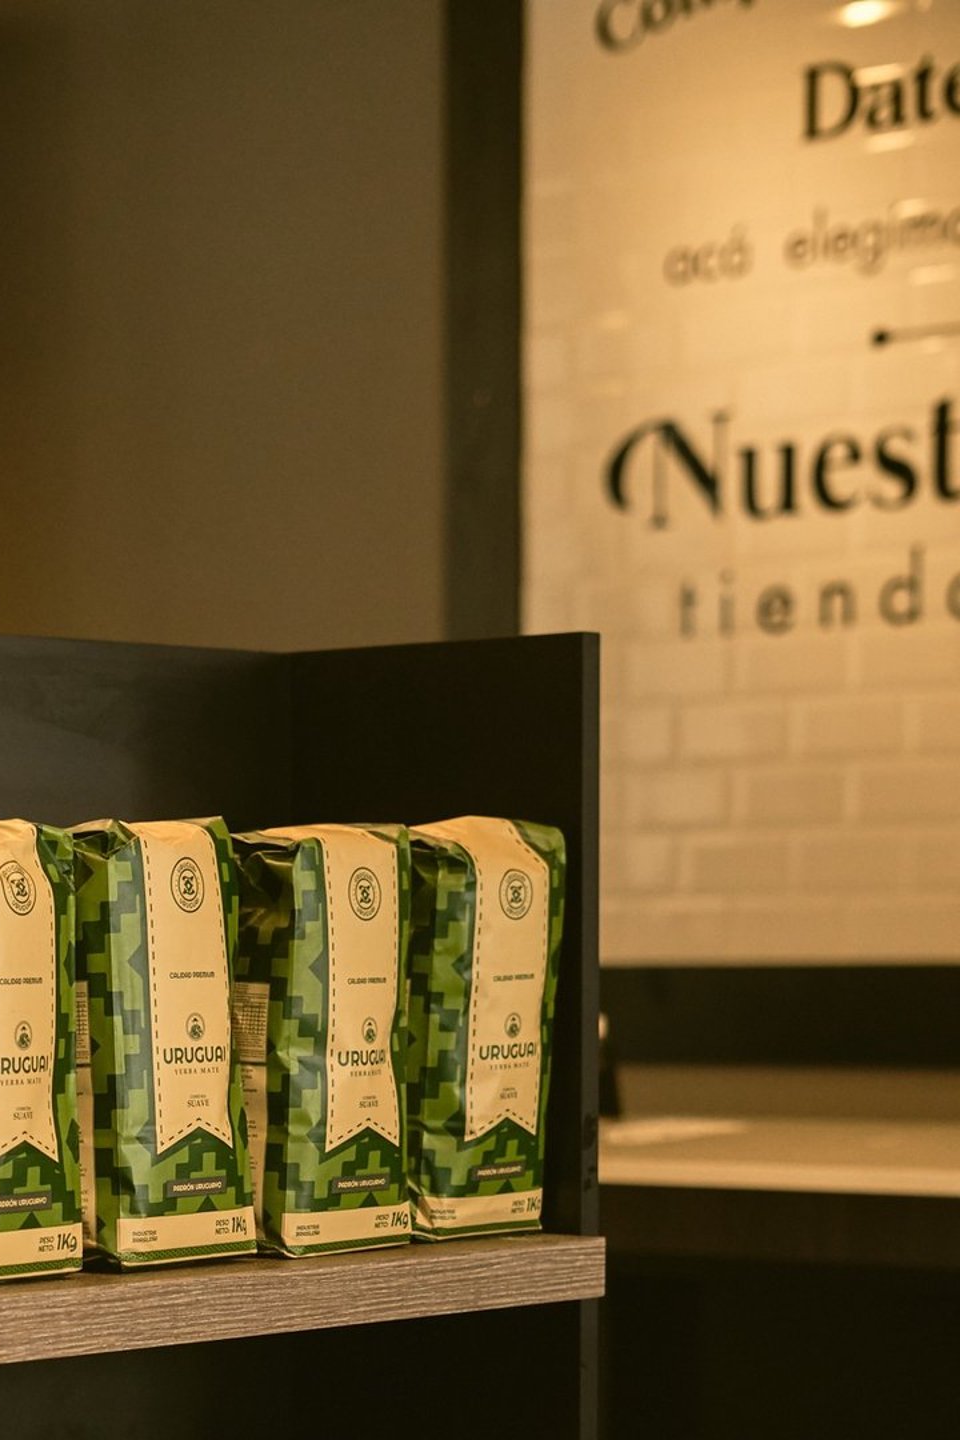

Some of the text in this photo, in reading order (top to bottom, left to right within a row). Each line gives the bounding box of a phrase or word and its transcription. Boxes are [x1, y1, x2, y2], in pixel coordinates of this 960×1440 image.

[0, 978, 21, 986] CALIDAD
[169, 972, 191, 980] CALIDAD
[163, 1046, 226, 1065] URUGUAI
[231, 1215, 247, 1236] 1Kg
[390, 1210, 409, 1229] 1Kg
[57, 1232, 78, 1252] 1Kg
